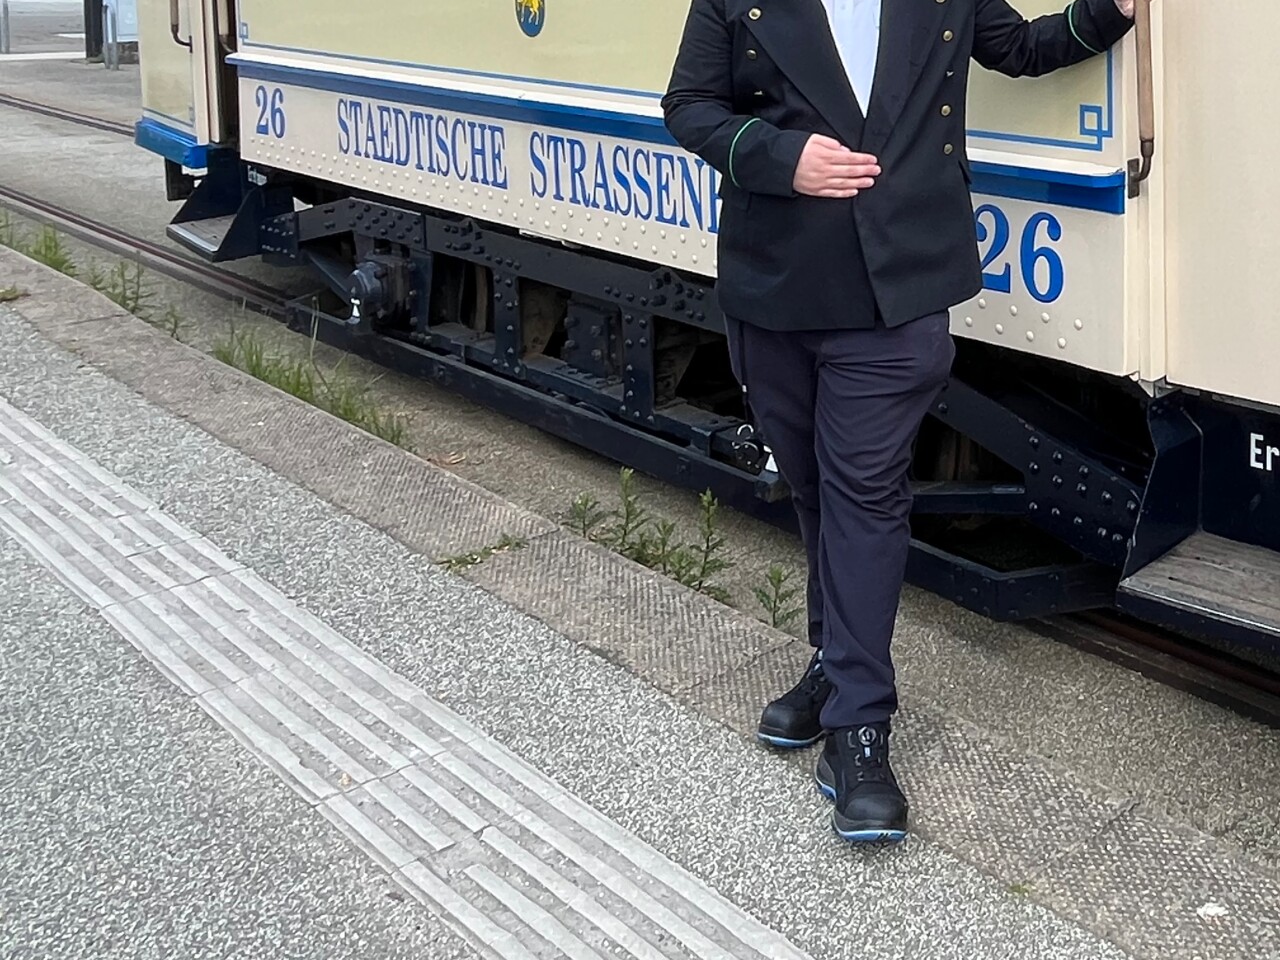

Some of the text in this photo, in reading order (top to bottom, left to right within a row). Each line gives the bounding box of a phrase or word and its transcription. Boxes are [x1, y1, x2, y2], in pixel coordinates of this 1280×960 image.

[255, 85, 286, 139] 26
[336, 98, 508, 191] STAEDTISCHE
[974, 203, 1065, 304] 26
